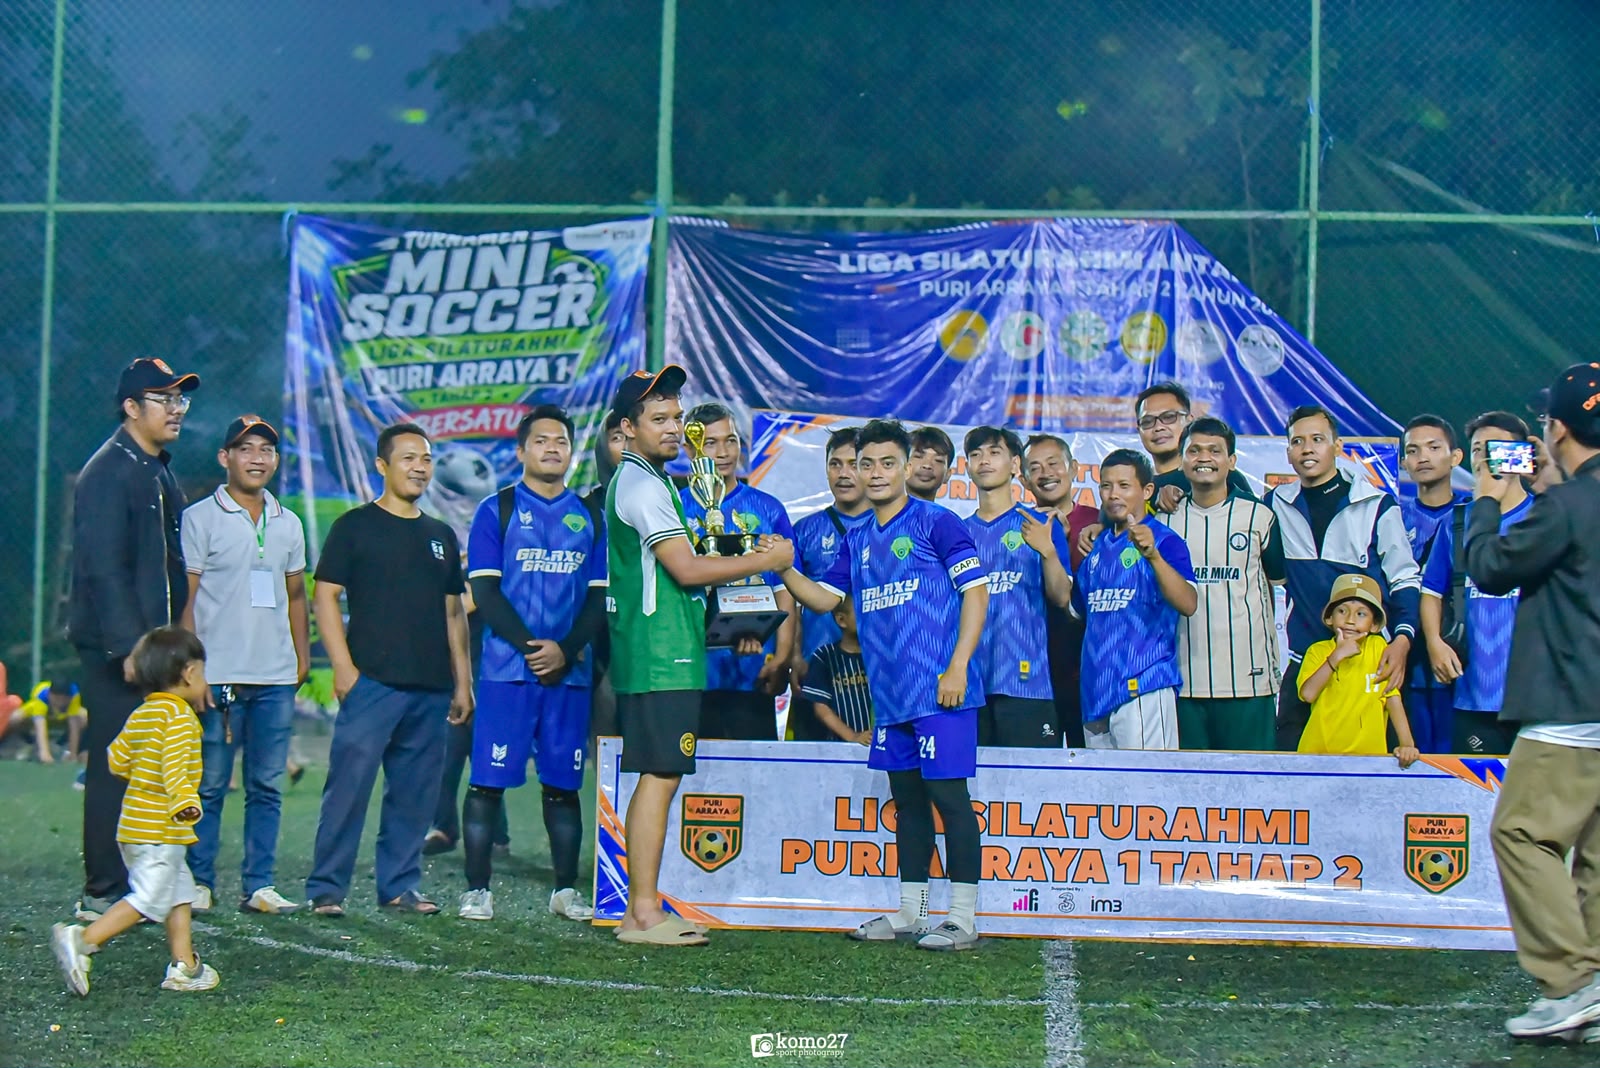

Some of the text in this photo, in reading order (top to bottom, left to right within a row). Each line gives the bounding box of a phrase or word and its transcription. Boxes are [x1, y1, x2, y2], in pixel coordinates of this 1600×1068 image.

[384, 242, 551, 294] MINI
[838, 252, 914, 274] LIGA
[1147, 249, 1239, 283] ANTA
[920, 280, 971, 298] PURI
[1160, 280, 1171, 297] 2
[342, 282, 597, 341] SOCCER
[370, 342, 413, 361] LIGA
[373, 356, 569, 393] PURI ARRAYA 1
[516, 547, 587, 565] GALAXY
[521, 560, 580, 574] GROUP
[1210, 567, 1240, 580] MIKA
[862, 591, 913, 614] GROUP
[1088, 600, 1128, 613] ROUP
[919, 735, 936, 760] 24
[573, 748, 582, 771] 9
[695, 807, 730, 815] ARRAYA
[1418, 827, 1455, 835] ARRAYA
[1427, 819, 1447, 827] PURI
[781, 838, 899, 877] PURI
[1118, 849, 1141, 885] 1
[1150, 850, 1323, 890] TAHAP
[1333, 854, 1364, 891] 2
[1058, 891, 1075, 913] 3
[1091, 896, 1122, 912] im3
